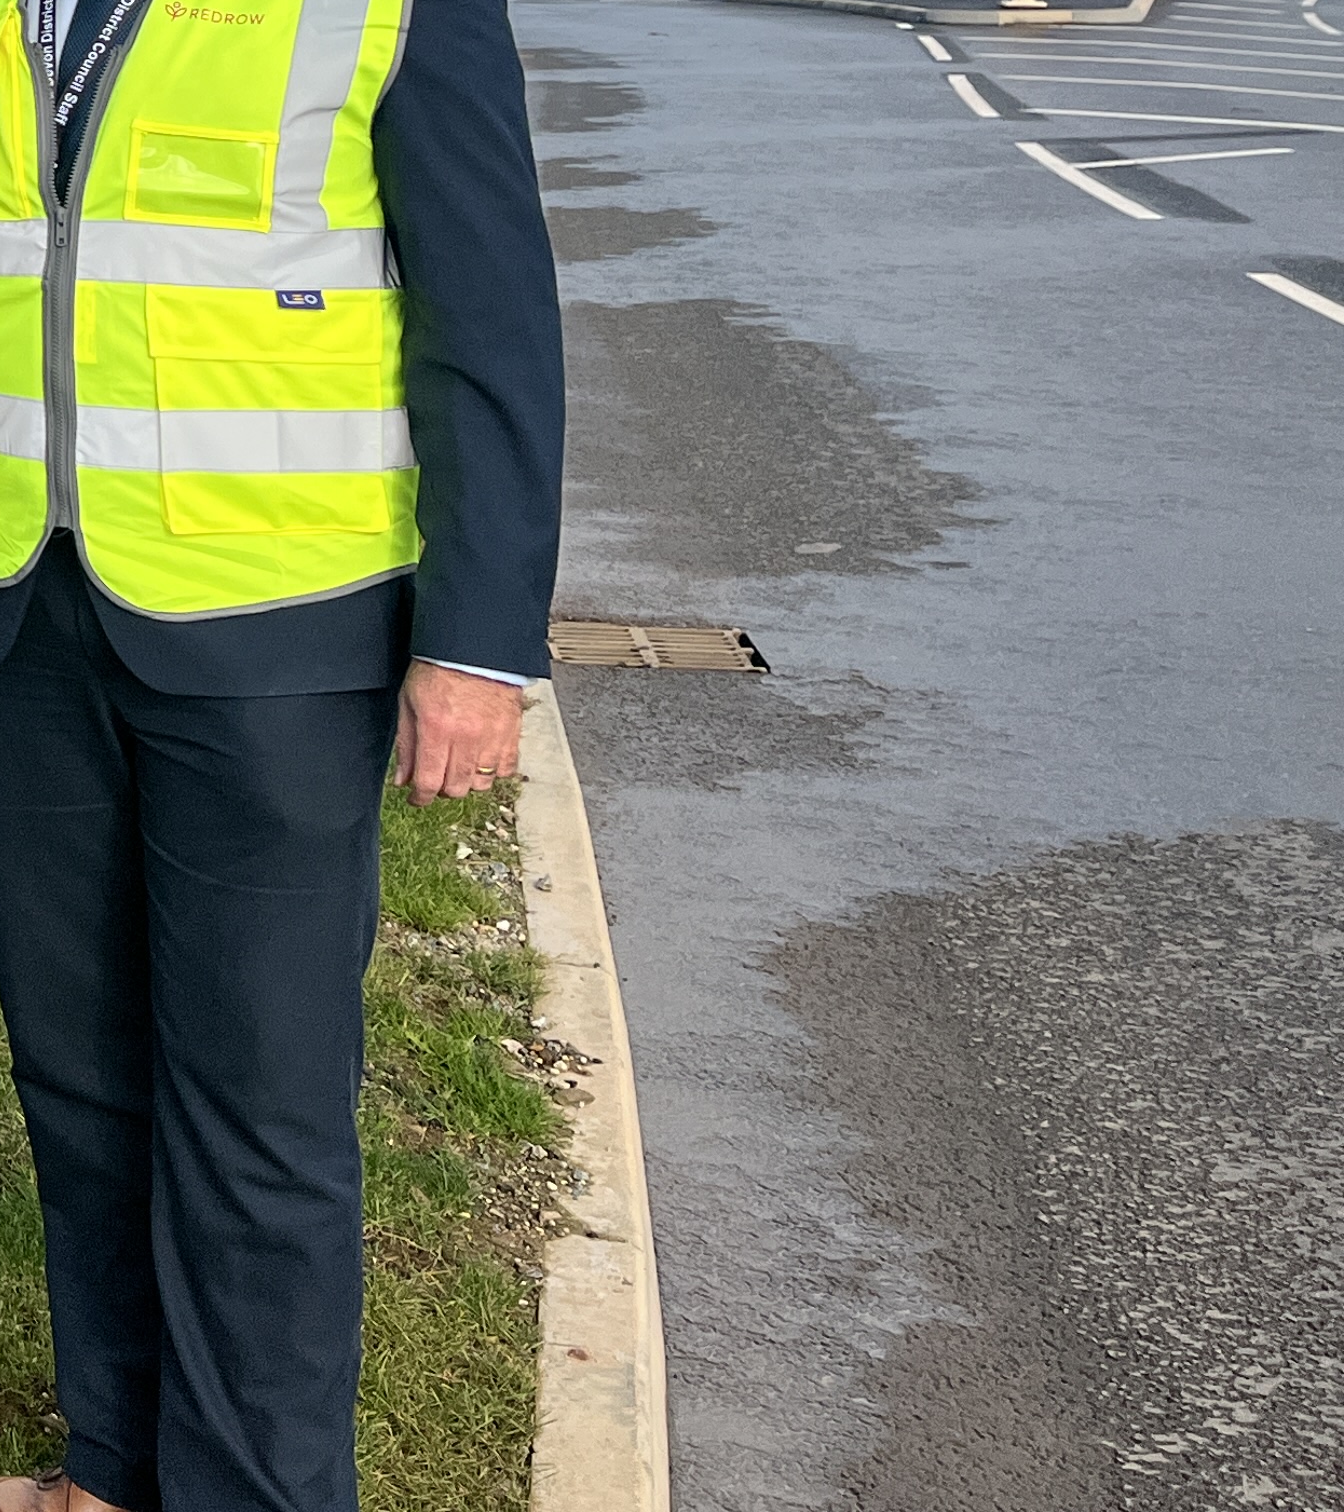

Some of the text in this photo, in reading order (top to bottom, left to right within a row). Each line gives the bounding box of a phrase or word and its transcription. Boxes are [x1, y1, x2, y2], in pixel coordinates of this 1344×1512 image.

[188, 8, 265, 25] REDROW
[69, 41, 106, 93] Council
[53, 92, 79, 126] Staff
